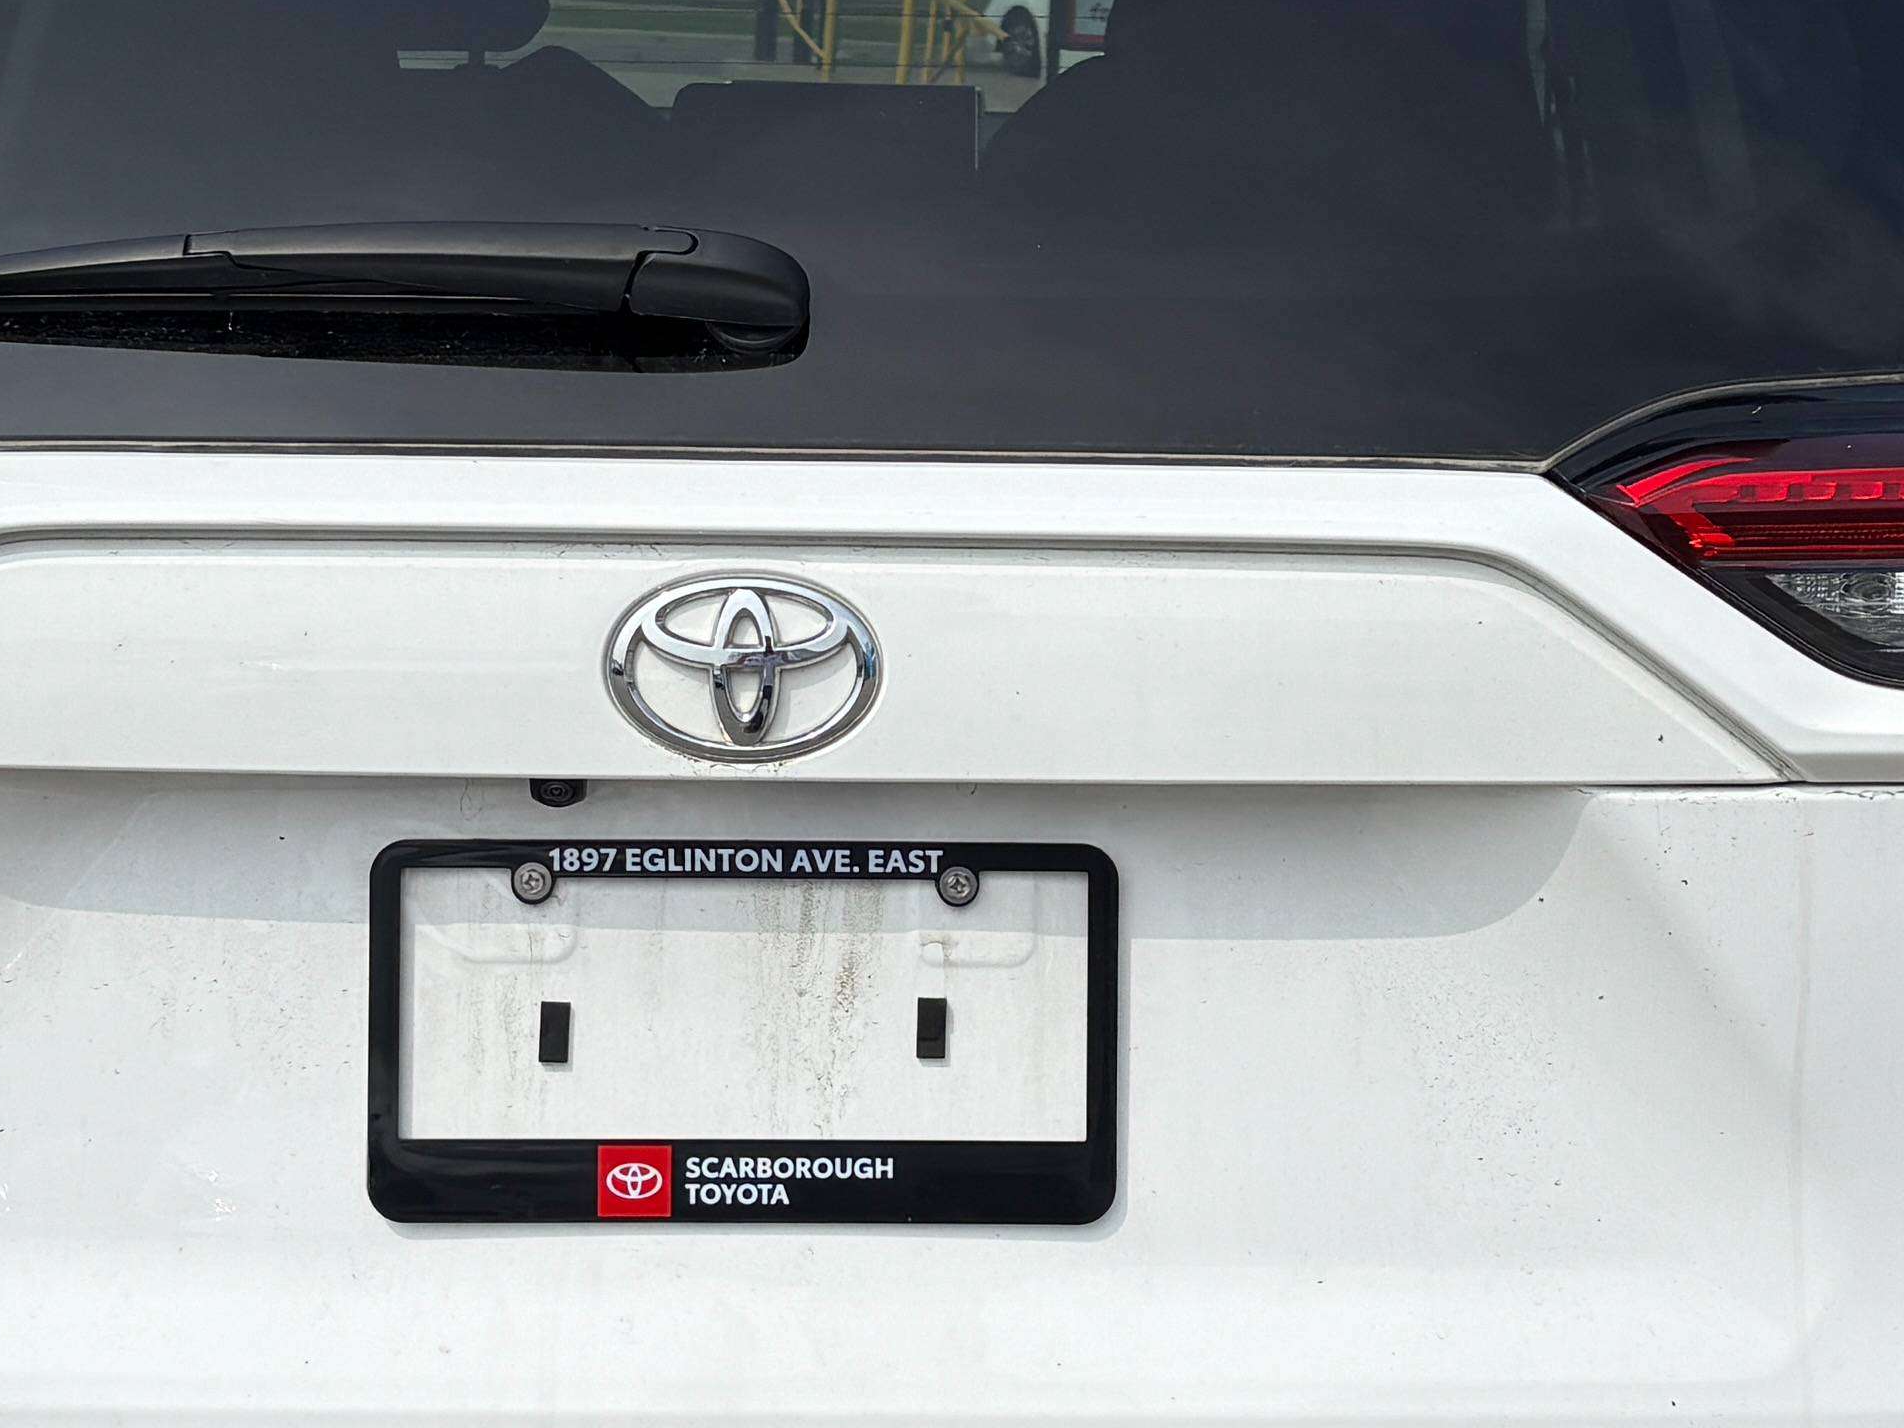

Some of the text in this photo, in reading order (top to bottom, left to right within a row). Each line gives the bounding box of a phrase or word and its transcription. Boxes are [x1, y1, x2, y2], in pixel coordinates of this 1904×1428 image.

[548, 848, 944, 875] 1897 EGLINTON AVE. EAST
[685, 1156, 895, 1180] SCARBOROUGH
[685, 1182, 790, 1207] TOYOTA
